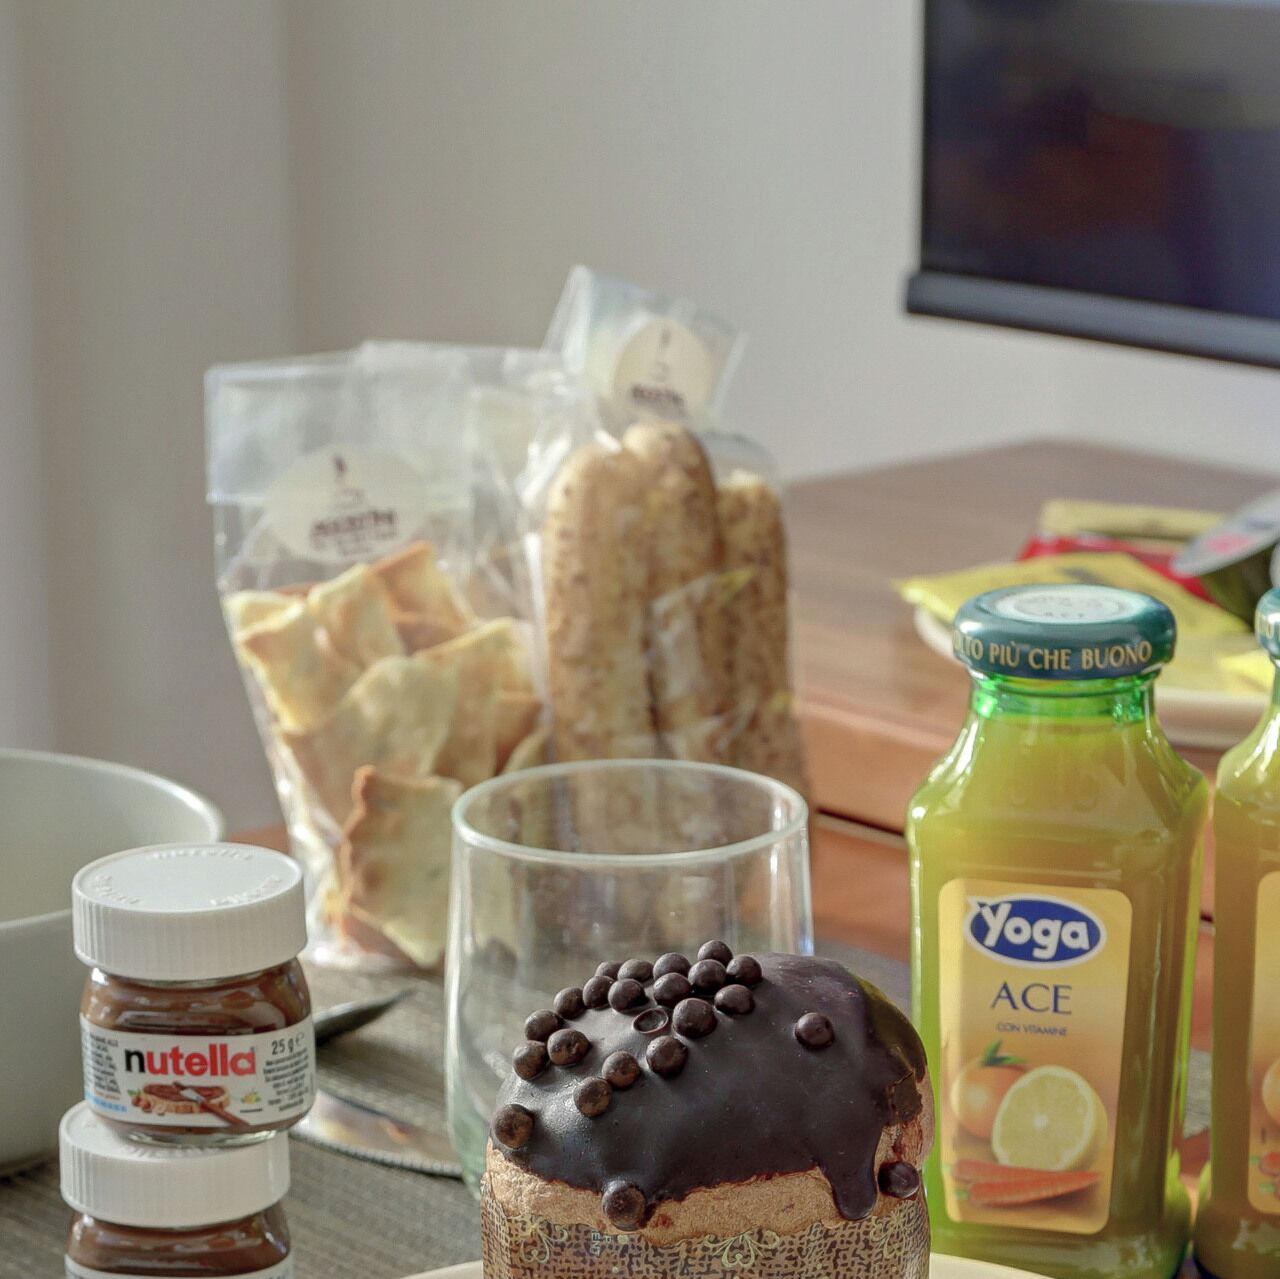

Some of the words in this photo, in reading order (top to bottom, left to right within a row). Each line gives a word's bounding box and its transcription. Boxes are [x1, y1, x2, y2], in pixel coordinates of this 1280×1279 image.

[988, 640, 1021, 668] PIÙ
[1028, 648, 1071, 671] CHE
[1081, 640, 1153, 670] BUONO
[980, 902, 1091, 960] Yoga
[990, 981, 1073, 1015] ACE
[997, 1022, 1021, 1033] CON
[124, 1043, 257, 1077] nutella
[271, 1038, 287, 1056] 25
